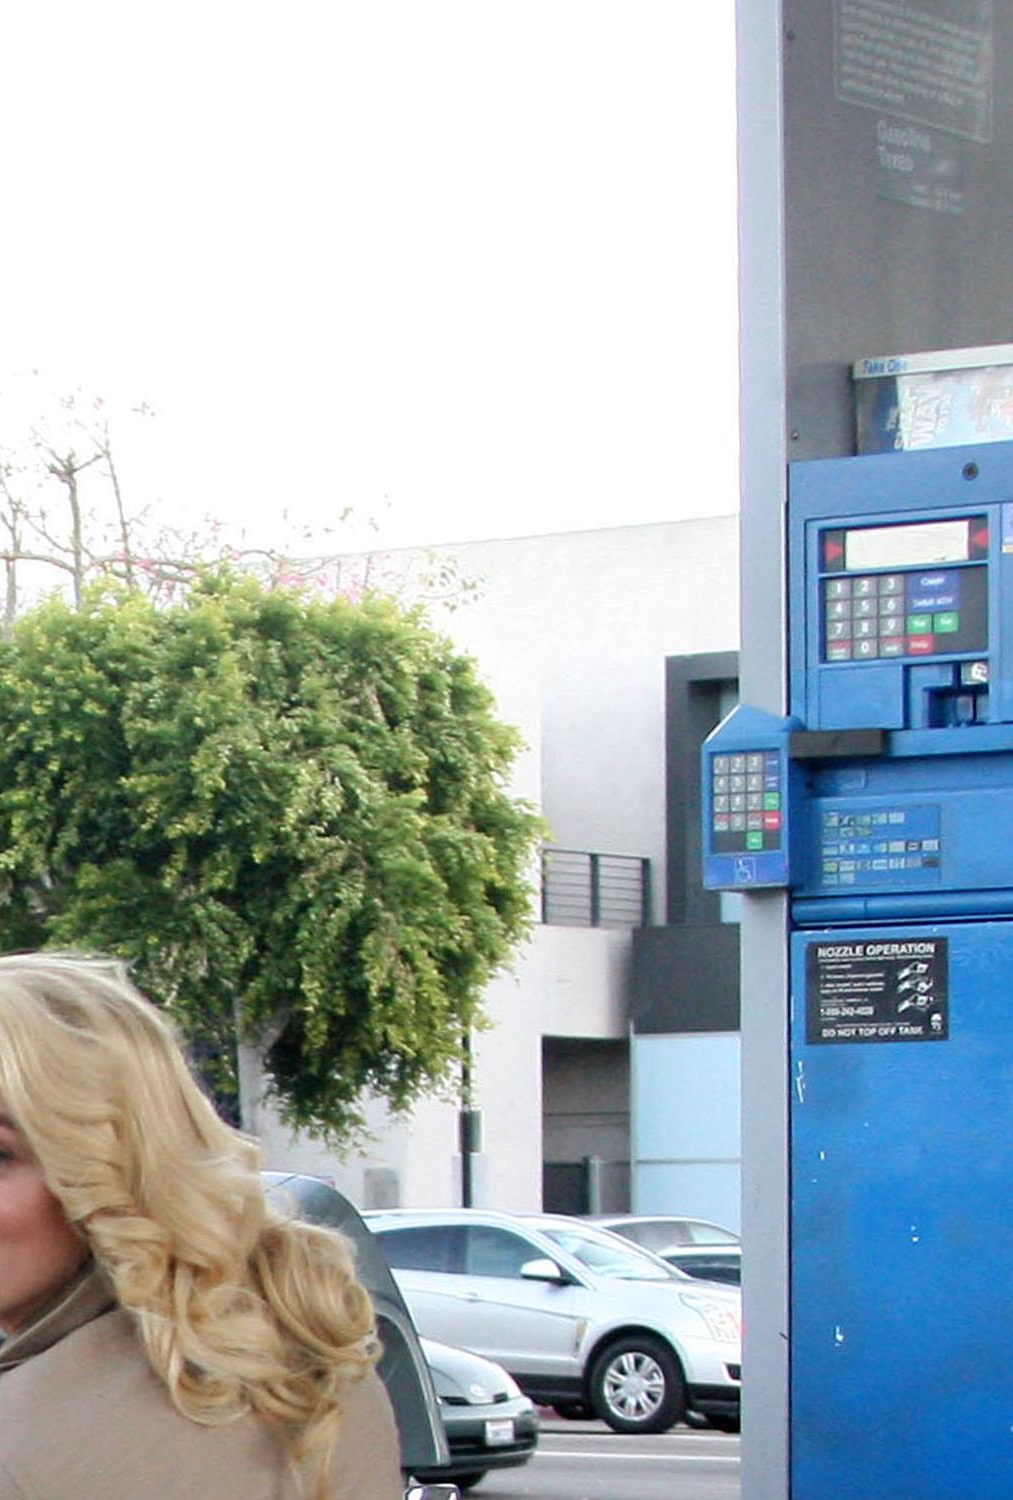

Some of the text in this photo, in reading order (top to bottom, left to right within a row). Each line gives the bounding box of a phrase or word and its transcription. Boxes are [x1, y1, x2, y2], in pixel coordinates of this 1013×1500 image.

[861, 580, 869, 592] 2
[888, 578, 895, 590] 3
[835, 599, 895, 613] 4 5 6
[835, 622, 843, 634] 7
[888, 619, 895, 631] 9
[861, 641, 869, 653] 0
[817, 943, 935, 958] NOZZLE OPERATION
[822, 1028, 836, 1038] DO
[837, 1028, 856, 1037] NOT
[859, 1027, 877, 1036] TOP
[899, 1026, 923, 1035] TANK
